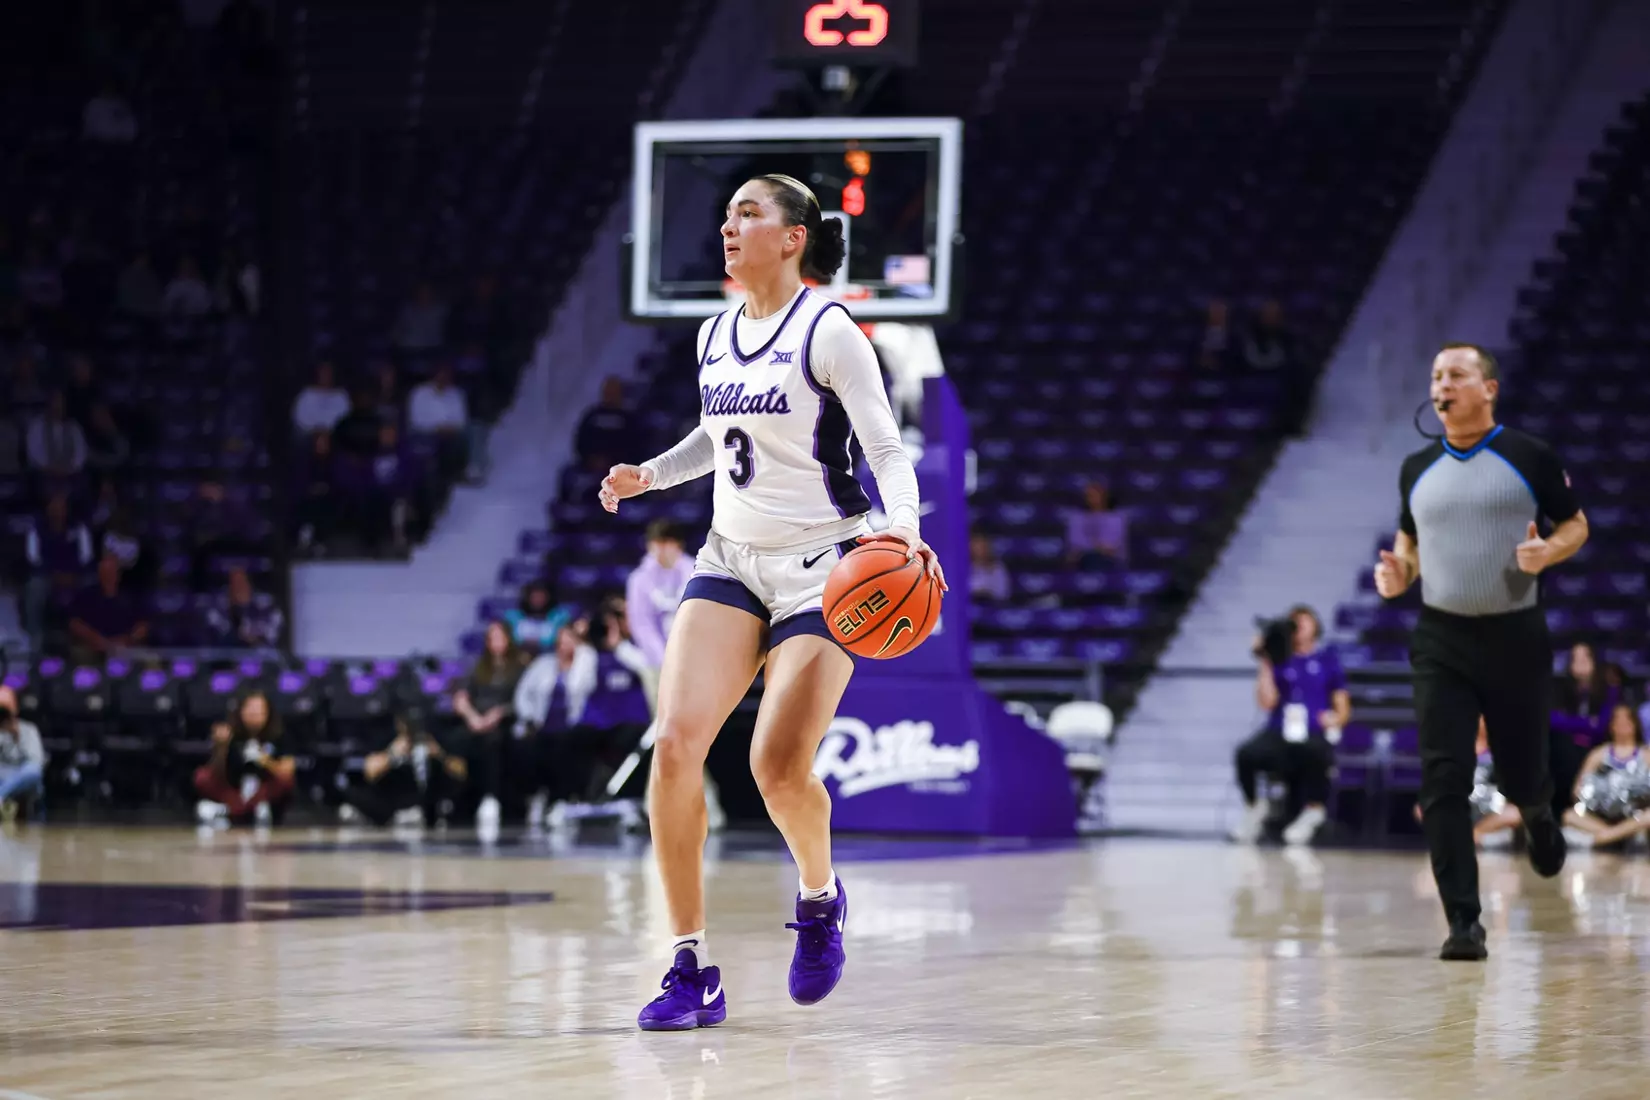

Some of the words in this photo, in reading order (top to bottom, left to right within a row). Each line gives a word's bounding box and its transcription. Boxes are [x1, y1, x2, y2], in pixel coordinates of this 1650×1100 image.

[701, 382, 792, 416] Wildcats
[723, 426, 755, 490] 3
[835, 588, 891, 637] ELITE
